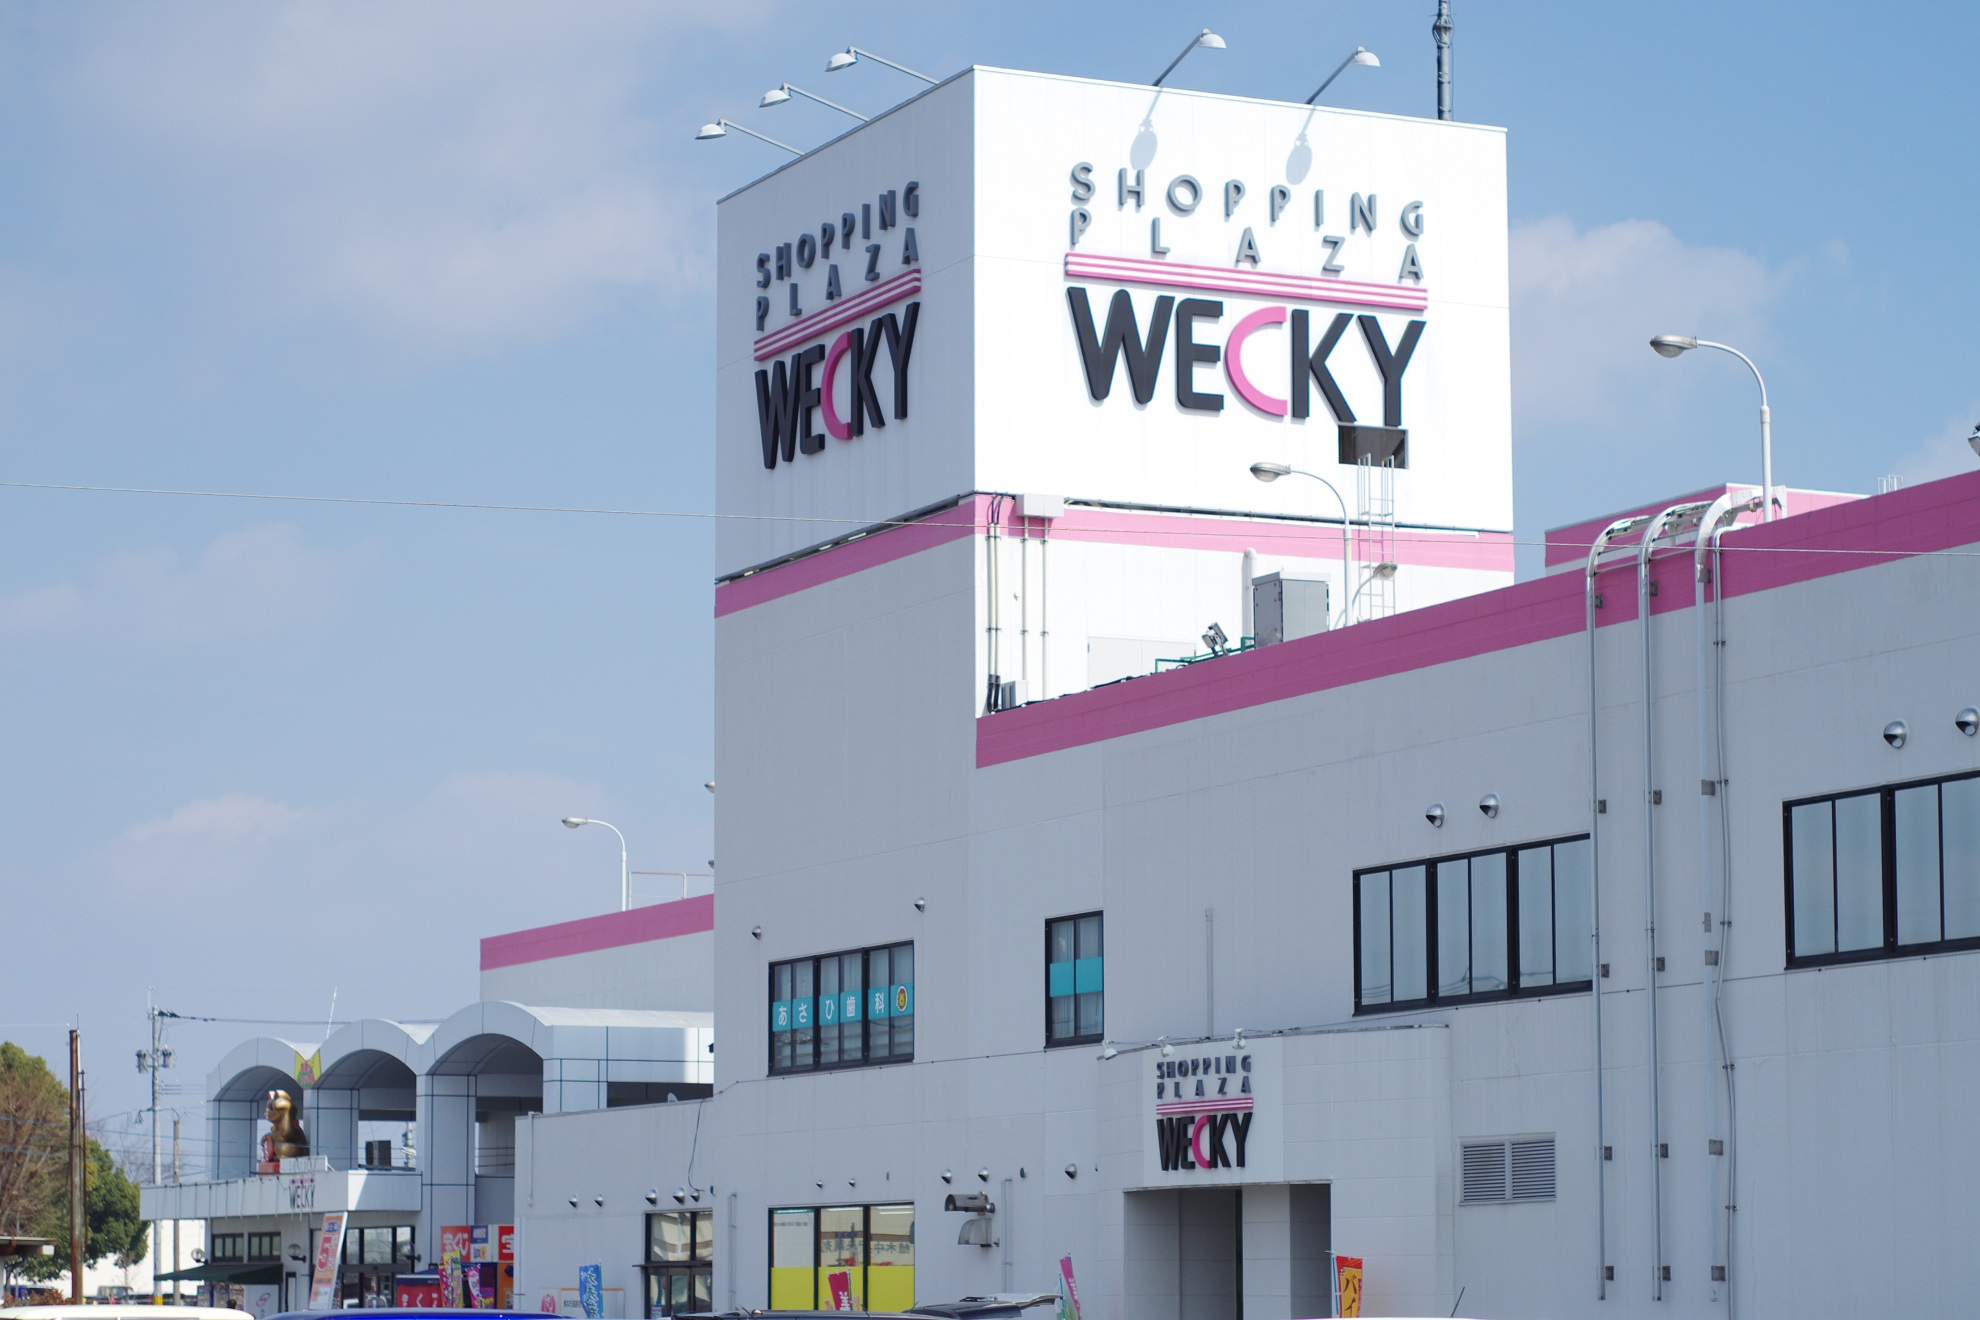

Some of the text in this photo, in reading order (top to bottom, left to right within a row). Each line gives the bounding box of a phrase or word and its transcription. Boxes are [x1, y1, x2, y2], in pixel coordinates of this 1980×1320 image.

[756, 180, 920, 289] SHOPPING
[1070, 161, 1424, 238] SHOPPING
[756, 227, 920, 331] PLAZA
[1069, 207, 1424, 281] PLAZA
[754, 301, 921, 470] WECKY
[1066, 286, 1427, 428] WECKY
[777, 992, 885, 1026] あさひ歯科
[1156, 1054, 1252, 1080] SHOPPING
[1156, 1076, 1252, 1099] PLAZA
[1156, 1111, 1253, 1171] WECKY
[288, 1183, 316, 1209] WECKY
